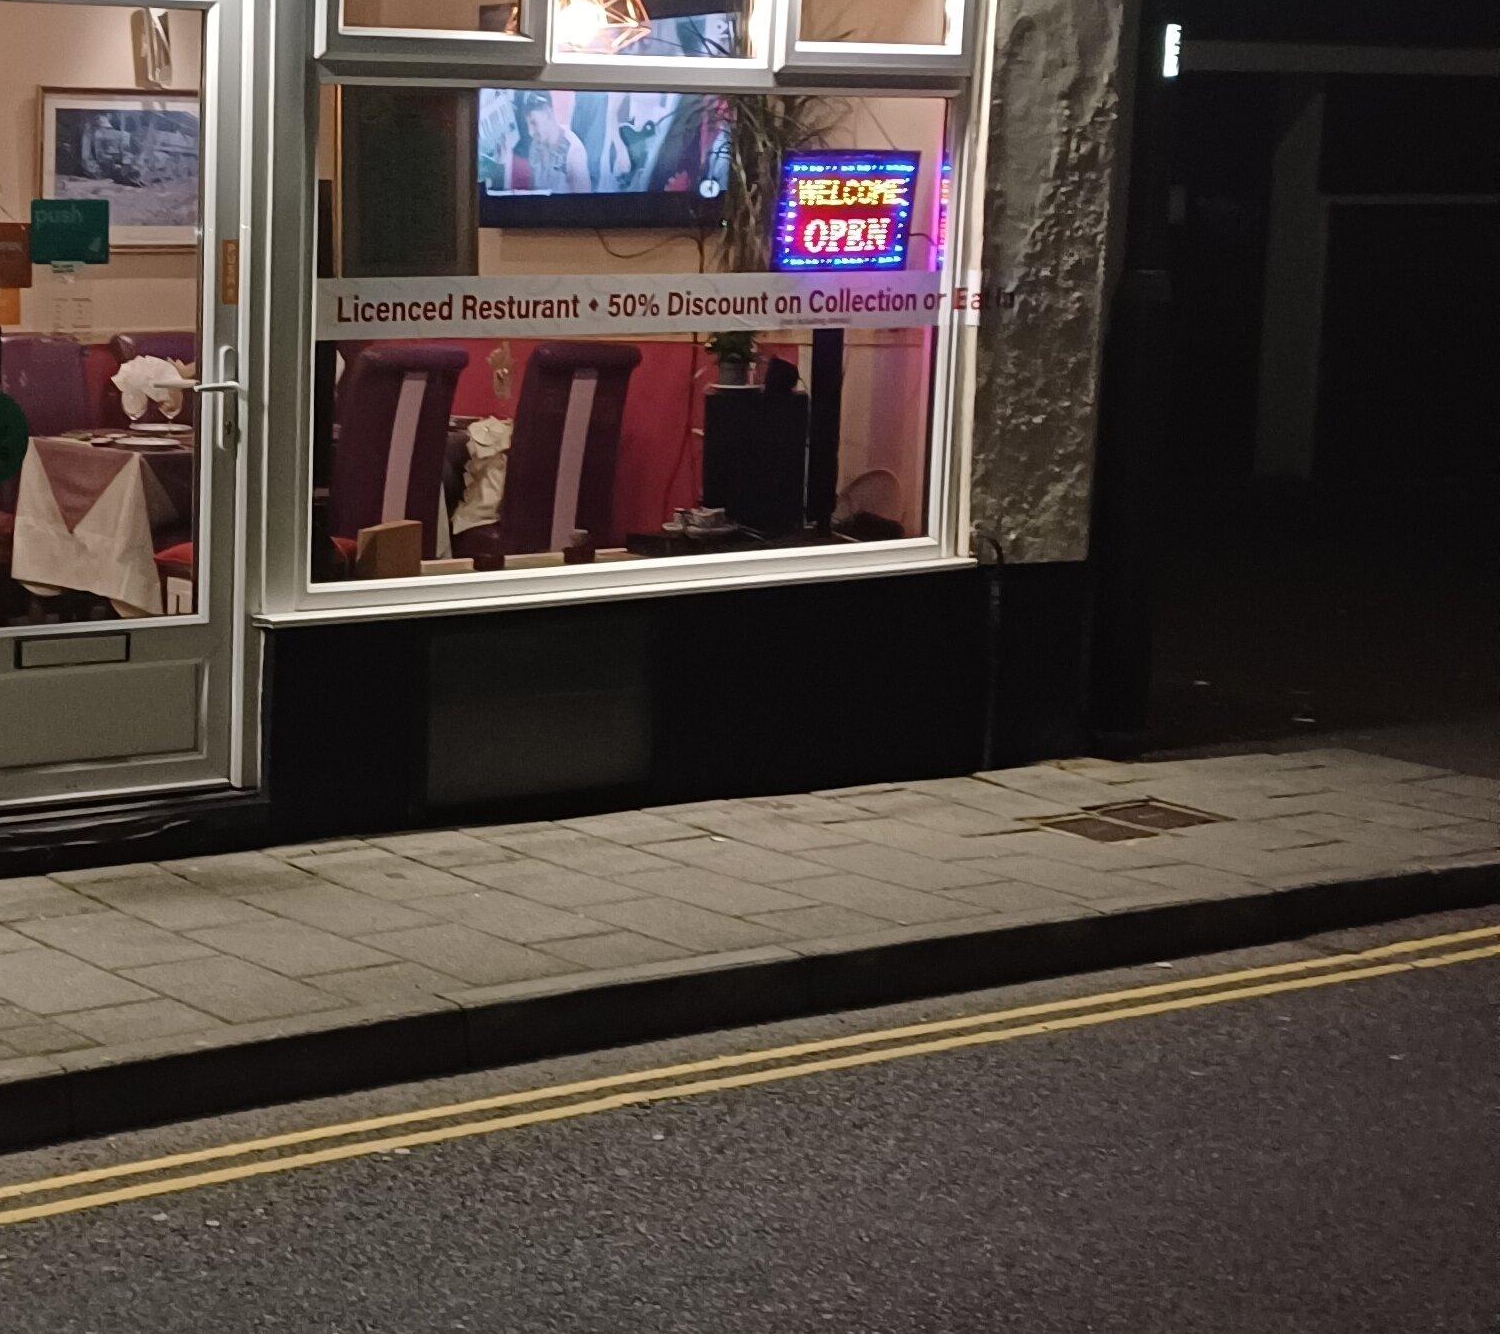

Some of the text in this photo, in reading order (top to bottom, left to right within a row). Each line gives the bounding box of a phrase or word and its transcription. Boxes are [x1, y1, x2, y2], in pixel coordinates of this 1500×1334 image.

[799, 178, 907, 206] WELCOME
[803, 217, 892, 254] OPEN
[336, 293, 454, 323] Licenced
[461, 293, 580, 320] Resturant
[607, 292, 660, 318] 50%
[668, 290, 769, 317] Discount
[775, 294, 801, 314] on
[809, 286, 918, 314] Collection
[923, 292, 947, 310] or
[952, 286, 987, 310] Ea
